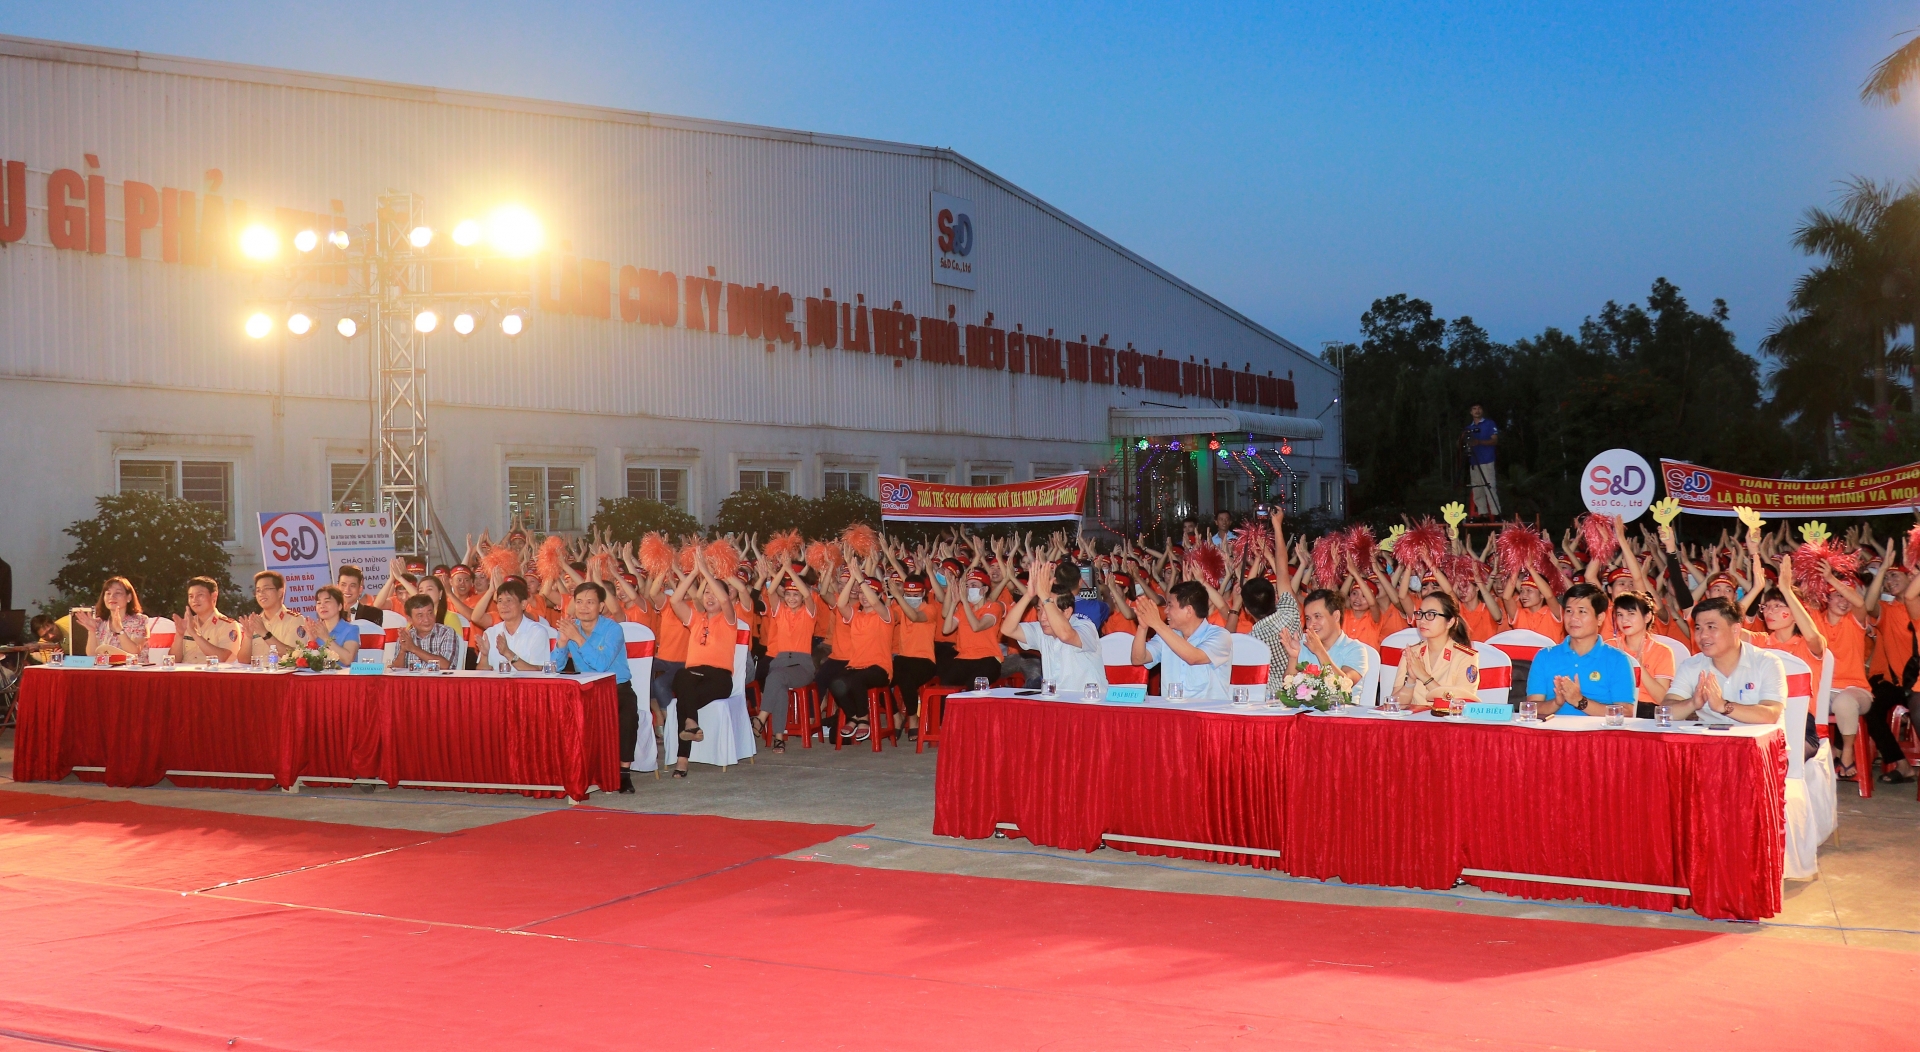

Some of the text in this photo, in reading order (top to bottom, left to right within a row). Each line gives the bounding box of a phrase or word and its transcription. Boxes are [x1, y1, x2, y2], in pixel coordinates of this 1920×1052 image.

[938, 208, 973, 256] S&D
[48, 154, 106, 254] GÌ
[619, 264, 679, 328] CHO
[686, 266, 722, 333] KỲ
[806, 288, 838, 350] DÙ
[842, 293, 870, 353] LÀ
[872, 300, 917, 368] VIỆC
[1589, 465, 1646, 495] S&D
[1667, 468, 1712, 494] S&D
[1860, 475, 1891, 486] GIAO
[881, 482, 912, 502] S&D
[945, 492, 959, 508] S&D
[973, 490, 997, 508] KHÔNG
[1011, 491, 1020, 507] TAI
[1038, 489, 1055, 506] GIAO
[1717, 486, 1918, 507] LÀ BẢO VỆ CHÍNH MÌNH VÀ MỌI
[345, 518, 365, 526] QBTV
[271, 526, 318, 561] S&D
[341, 556, 363, 564] CHÀO
